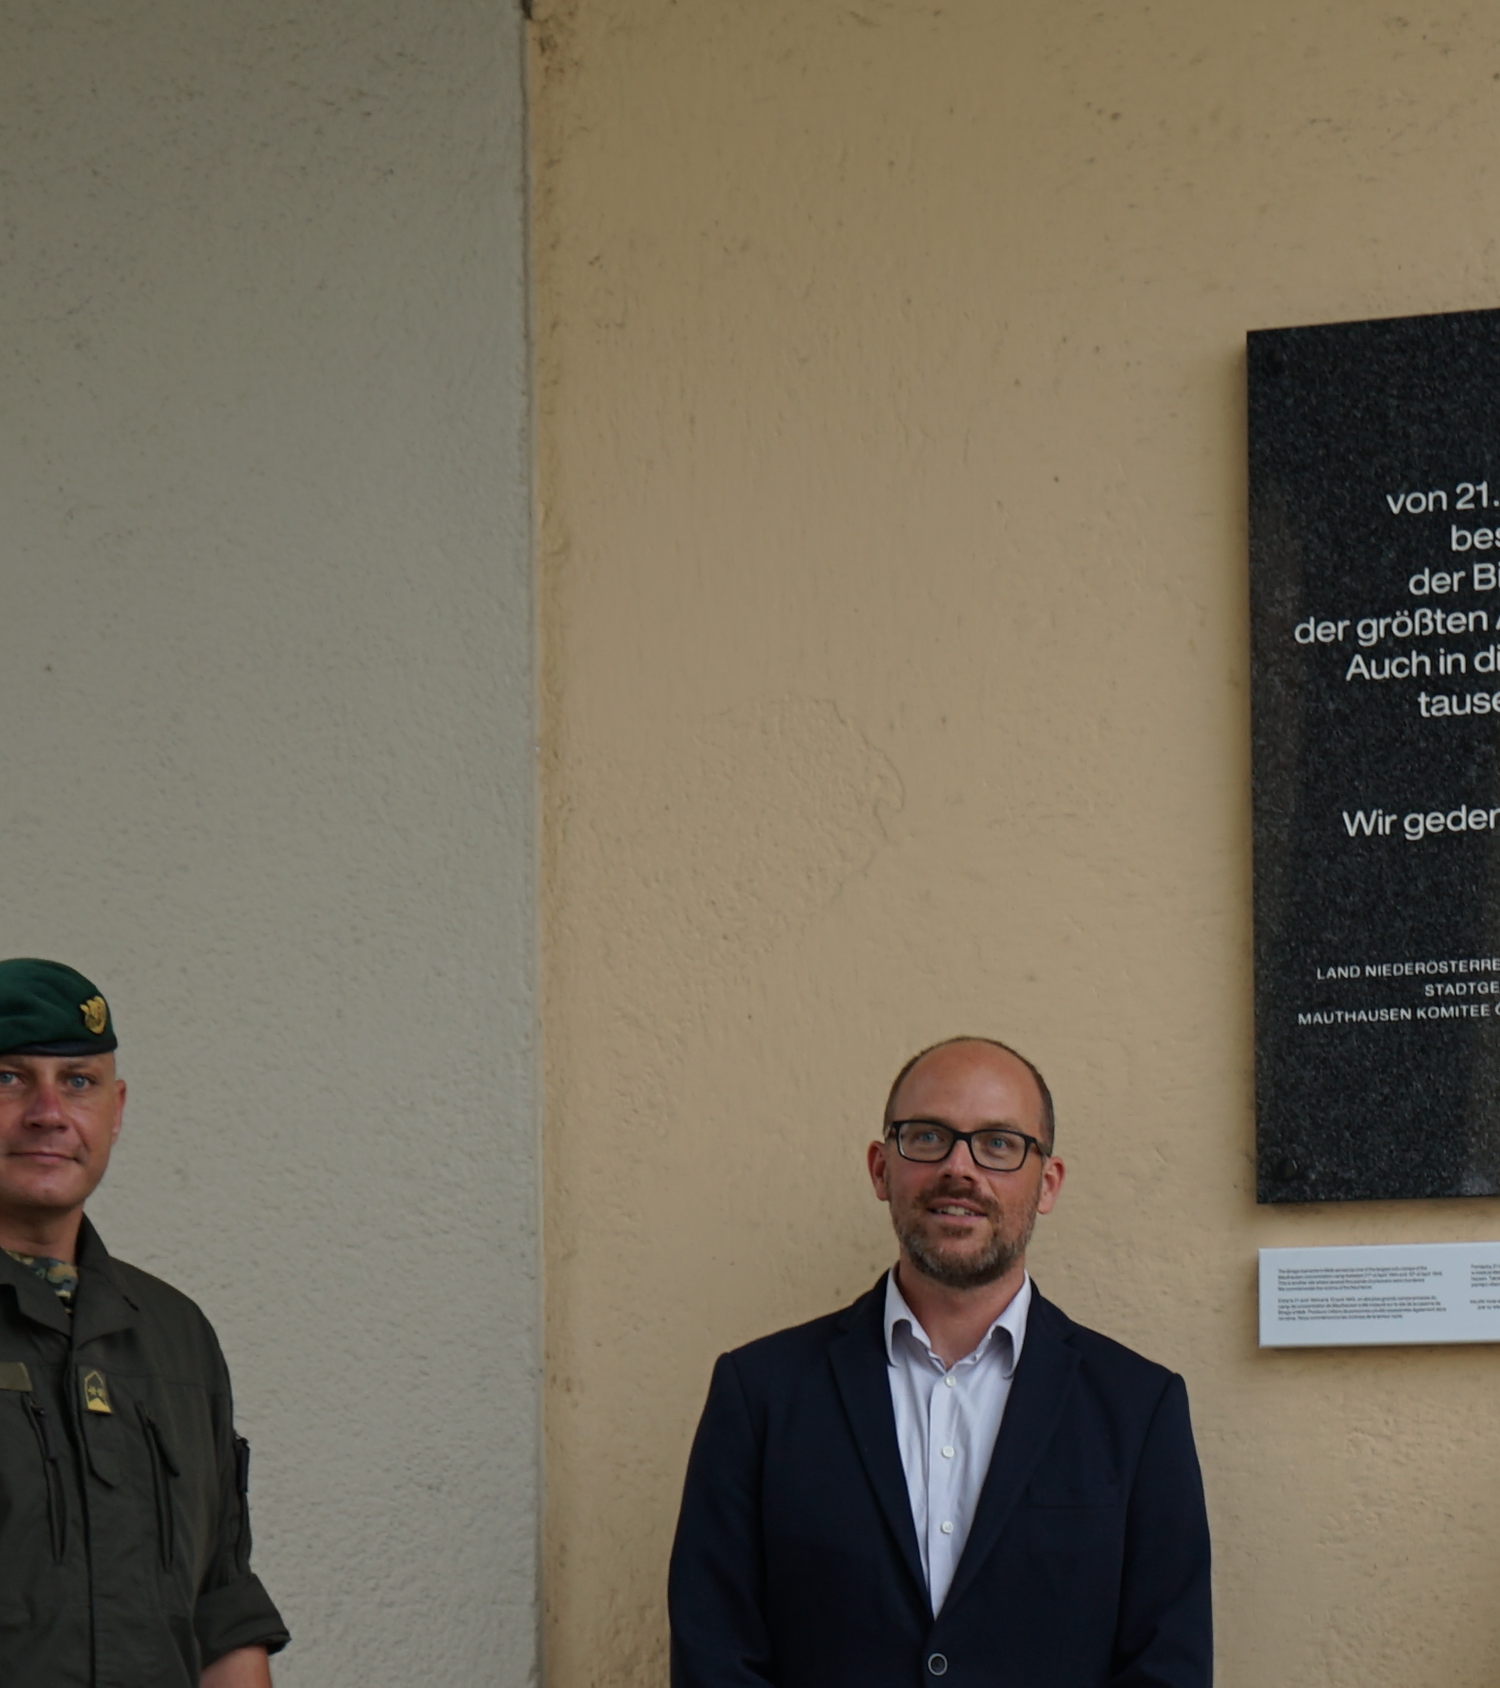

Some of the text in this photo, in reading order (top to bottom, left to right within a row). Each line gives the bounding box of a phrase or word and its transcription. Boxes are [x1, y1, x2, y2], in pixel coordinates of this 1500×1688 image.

[1385, 489, 1448, 515] von
[1455, 480, 1500, 511] 21.
[1408, 566, 1467, 596] der
[1293, 615, 1351, 645] der
[1356, 607, 1489, 648] größten
[1345, 649, 1432, 682] Auch
[1438, 647, 1467, 676] in
[1341, 808, 1398, 838] Wir
[1316, 964, 1361, 981] LAND
[1297, 1007, 1412, 1026] MAUTHAUSEN
[1416, 1003, 1491, 1020] KOMITEE
